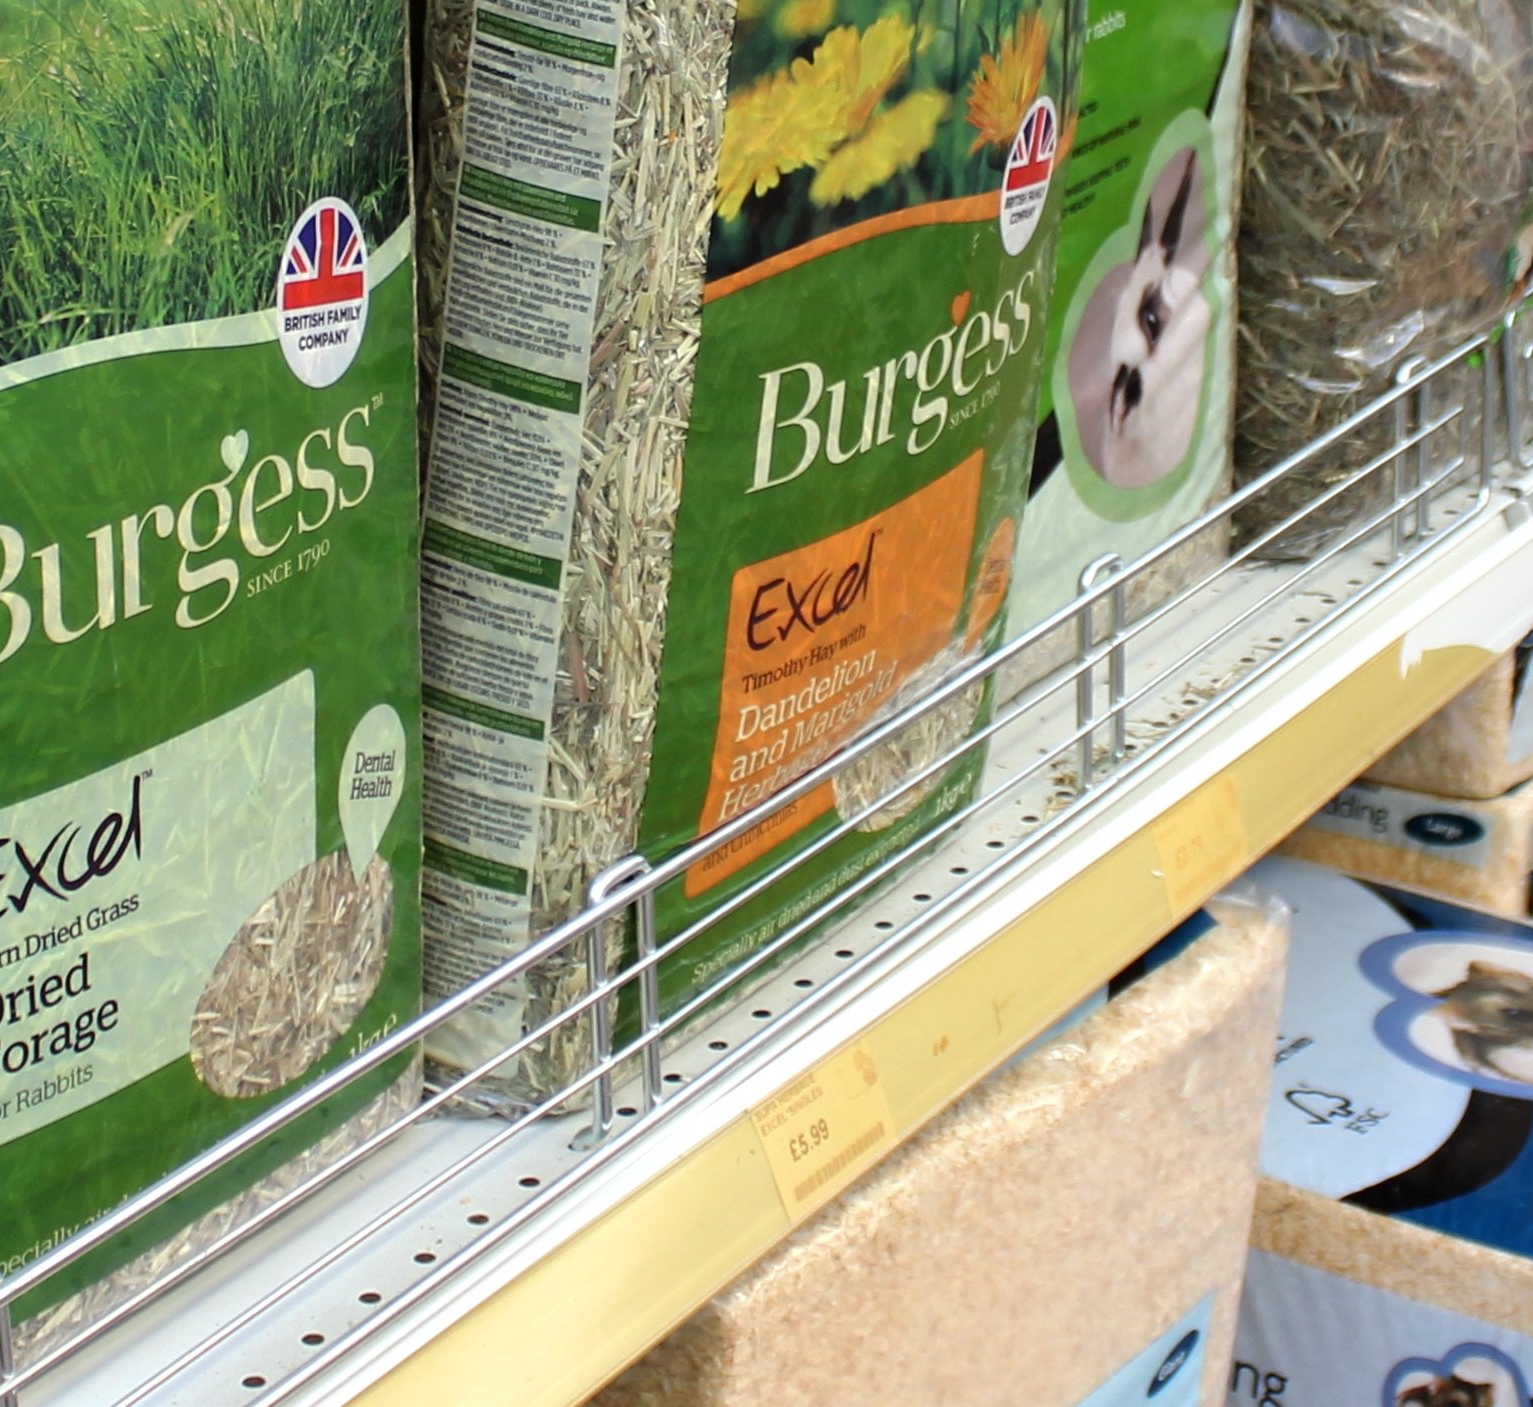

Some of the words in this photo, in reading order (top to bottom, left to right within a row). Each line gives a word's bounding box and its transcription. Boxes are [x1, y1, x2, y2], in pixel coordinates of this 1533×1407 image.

[284, 311, 325, 333] BRITISH
[327, 305, 362, 324] FAMILY
[298, 328, 349, 351] COMPANY
[745, 270, 1035, 494] Burgess
[949, 401, 979, 430] SINCE
[246, 560, 293, 599] SINCE
[296, 538, 330, 578] 1790
[746, 530, 876, 652] Excel
[742, 653, 809, 694] Timothy
[810, 642, 837, 668] Hay
[839, 624, 867, 651] with
[729, 730, 789, 783] and
[791, 660, 899, 749] Marigold
[735, 650, 877, 743] Dandelion
[350, 775, 393, 801] Health
[354, 748, 395, 775] Dental
[24, 913, 83, 958] Dried
[86, 893, 140, 932] Grass
[758, 919, 775, 942] air
[777, 900, 810, 929] dried
[810, 877, 837, 904] and
[15, 1062, 94, 1114] Rabbits
[789, 1118, 830, 1163] £5.99
[1344, 1107, 1390, 1135] FSC
